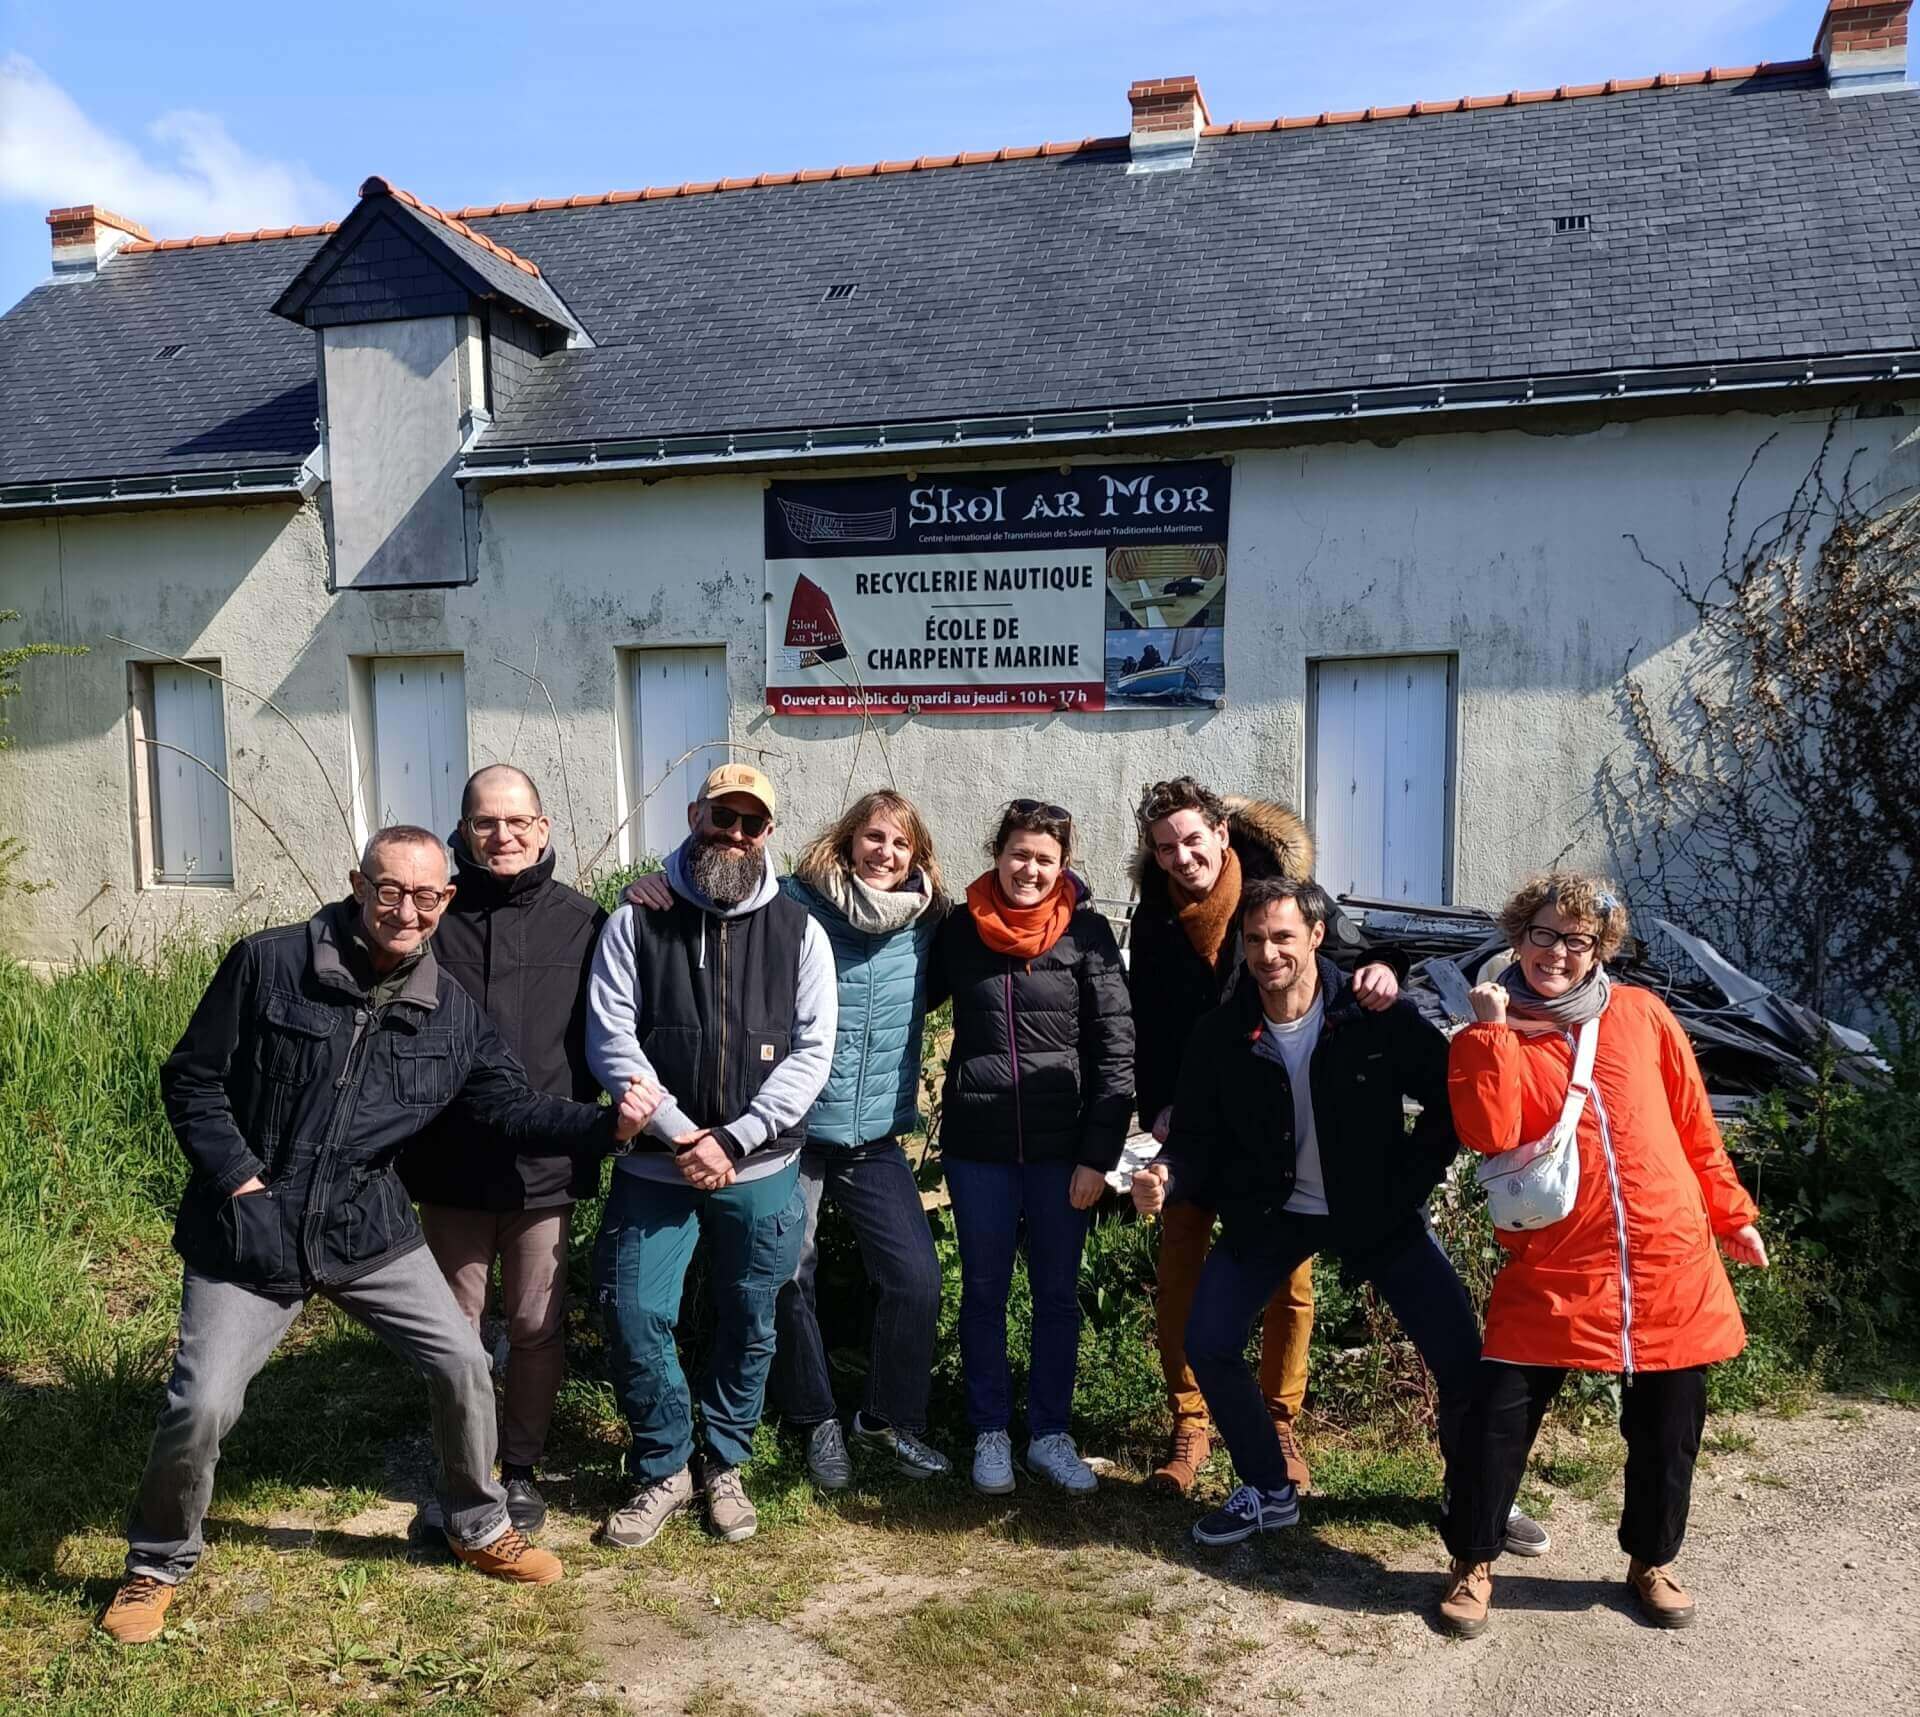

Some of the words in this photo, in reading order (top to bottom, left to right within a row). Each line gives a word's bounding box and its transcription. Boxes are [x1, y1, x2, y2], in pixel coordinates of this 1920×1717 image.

[909, 484, 1007, 528] Skol
[918, 534, 943, 543] Centre
[944, 532, 992, 542] International
[992, 531, 1003, 541] de
[1004, 529, 1053, 540] Transmission
[1053, 529, 1068, 538] des
[1068, 527, 1111, 537] Savoir-faire
[1112, 525, 1162, 535] Traditionnels
[1163, 523, 1203, 533] Maritimes
[856, 570, 977, 595] RECYCLERIE
[984, 565, 1093, 591] NAUTIQUE
[925, 615, 987, 641] ÉCOLE
[993, 617, 1019, 640] DE
[867, 646, 988, 670] CHARPENTE
[994, 645, 1079, 668] MARINE
[781, 694, 826, 706] Ouvert
[830, 695, 845, 706] au
[891, 692, 909, 705] du
[912, 691, 950, 705] mardi
[953, 694, 970, 704] au
[971, 690, 1008, 707] jeudi
[1019, 690, 1036, 703] 10
[1039, 690, 1048, 702] h
[1059, 689, 1075, 703] 17
[1078, 689, 1087, 702] h
